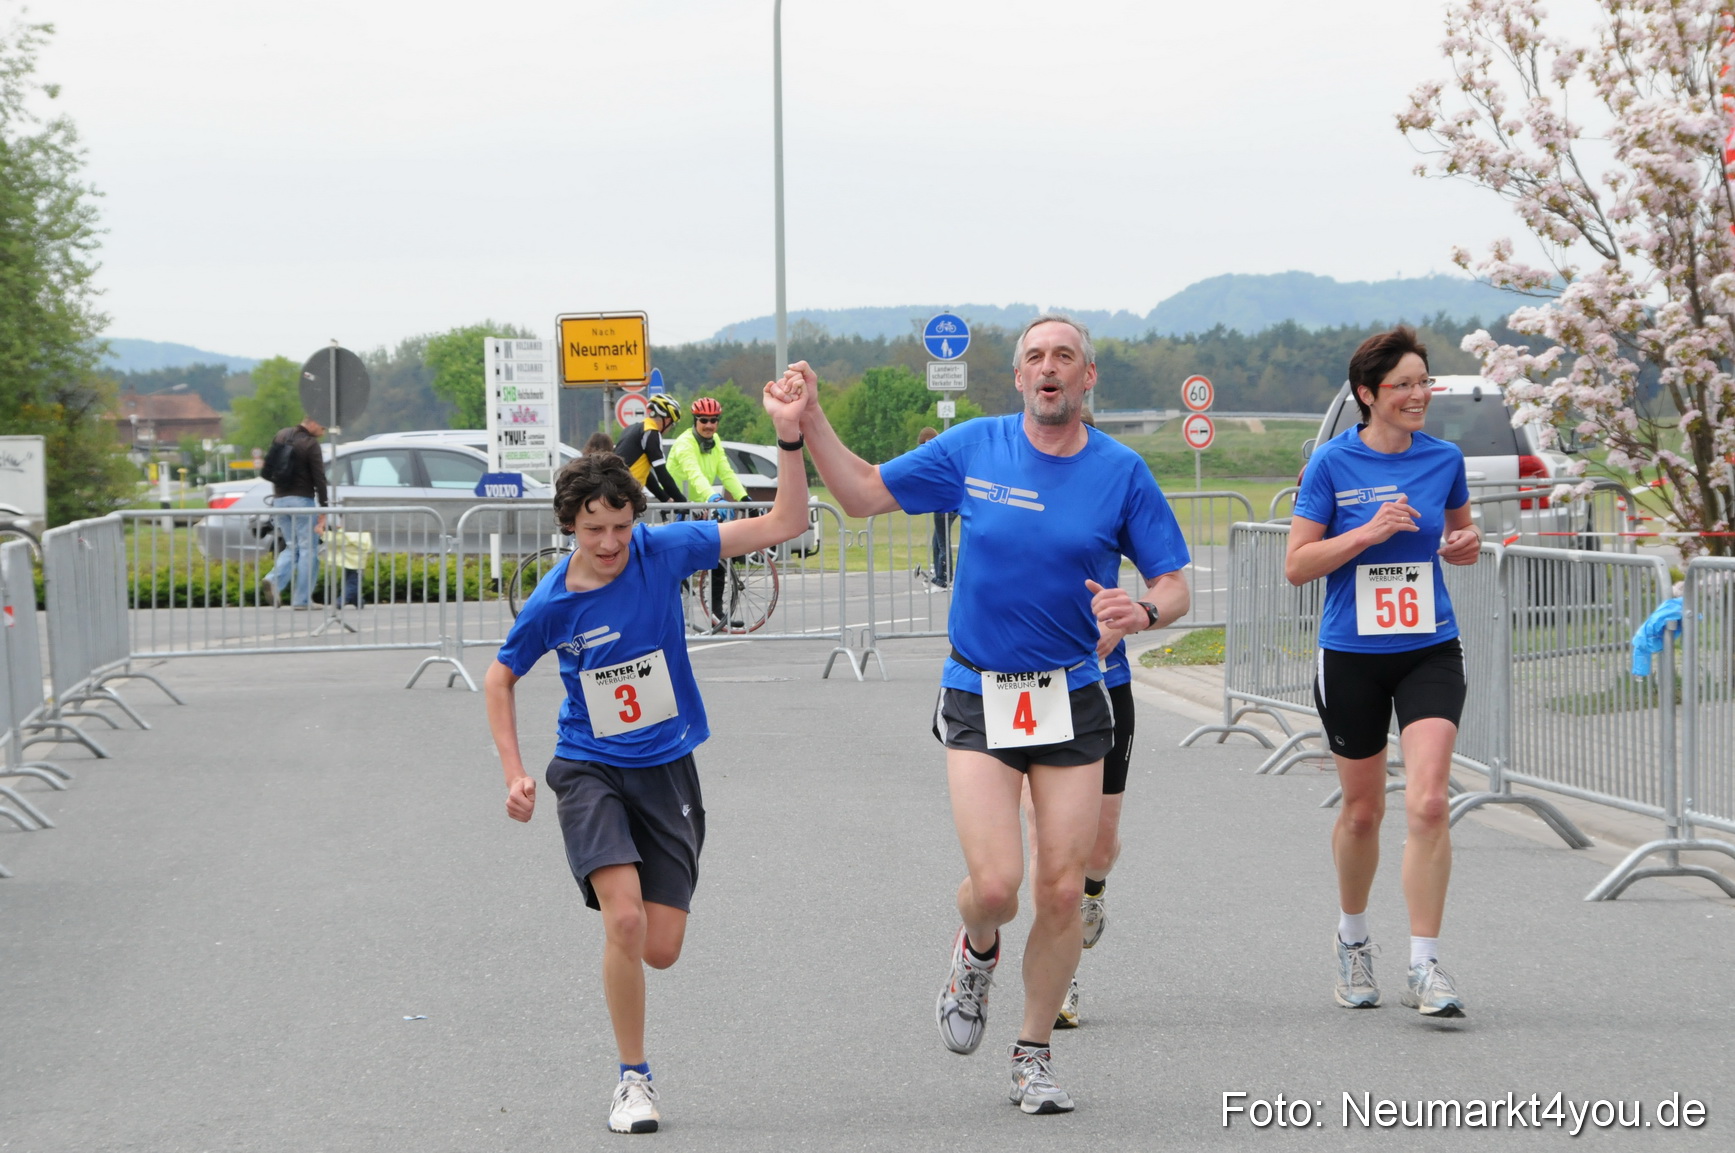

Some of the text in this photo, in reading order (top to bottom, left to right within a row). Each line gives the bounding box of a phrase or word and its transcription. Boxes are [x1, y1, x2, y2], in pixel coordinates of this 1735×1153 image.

[592, 328, 616, 336] Nach
[570, 340, 638, 357] Neumarkt
[593, 362, 618, 371] 5 km
[1190, 386, 1207, 402] 60
[504, 430, 527, 446] THULE
[484, 484, 518, 497] VOLVO
[1369, 567, 1403, 576] MEYER
[1375, 586, 1419, 628] 56
[595, 665, 635, 681] MEYER
[596, 672, 637, 687] WERBUNG
[996, 672, 1035, 683] MEYER
[996, 680, 1036, 690] WERBUNG
[614, 684, 642, 723] 3
[1012, 691, 1037, 736] 4
